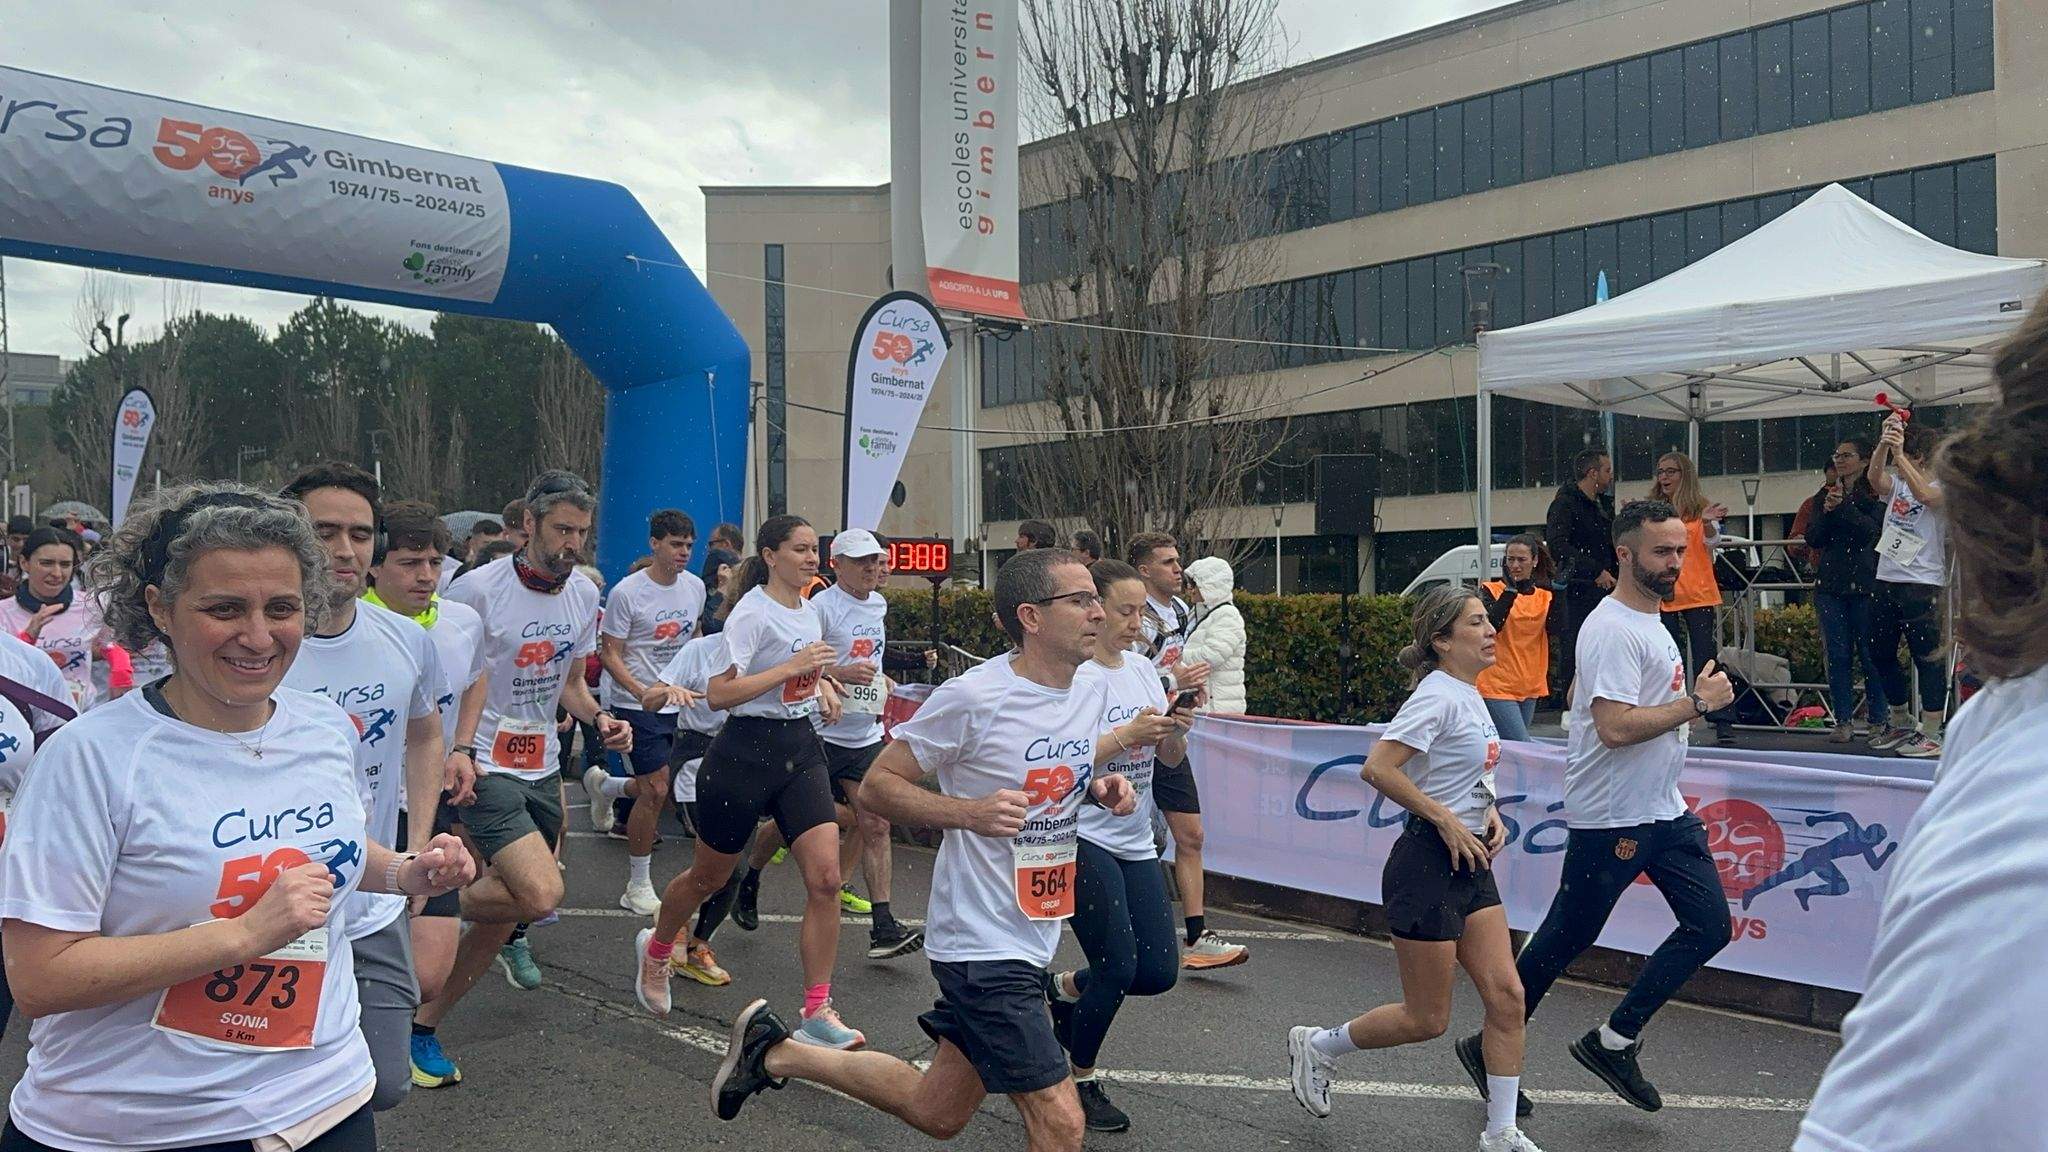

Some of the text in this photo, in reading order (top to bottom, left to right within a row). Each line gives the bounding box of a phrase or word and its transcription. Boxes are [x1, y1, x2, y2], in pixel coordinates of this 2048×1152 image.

[0, 97, 132, 148] rsa
[324, 150, 483, 193] Gimbernat
[951, 131, 972, 229] escoles
[208, 184, 255, 204] anys
[410, 240, 432, 250] Fons
[426, 260, 476, 282] family
[878, 309, 930, 332] Cursa
[872, 331, 914, 363] 50
[871, 372, 925, 390] Gimbernat
[871, 439, 896, 453] family
[655, 609, 688, 622] Cursa
[521, 620, 571, 638] Cursa
[852, 625, 881, 637] Cursa
[853, 686, 878, 701] 996
[507, 736, 536, 754] 695
[1025, 737, 1090, 762] Cursa
[212, 802, 334, 848] Cursa
[1031, 867, 1067, 897] 564
[205, 963, 300, 1010] 873
[220, 1012, 269, 1029] SONIA
[225, 1029, 256, 1041] 5 Km
